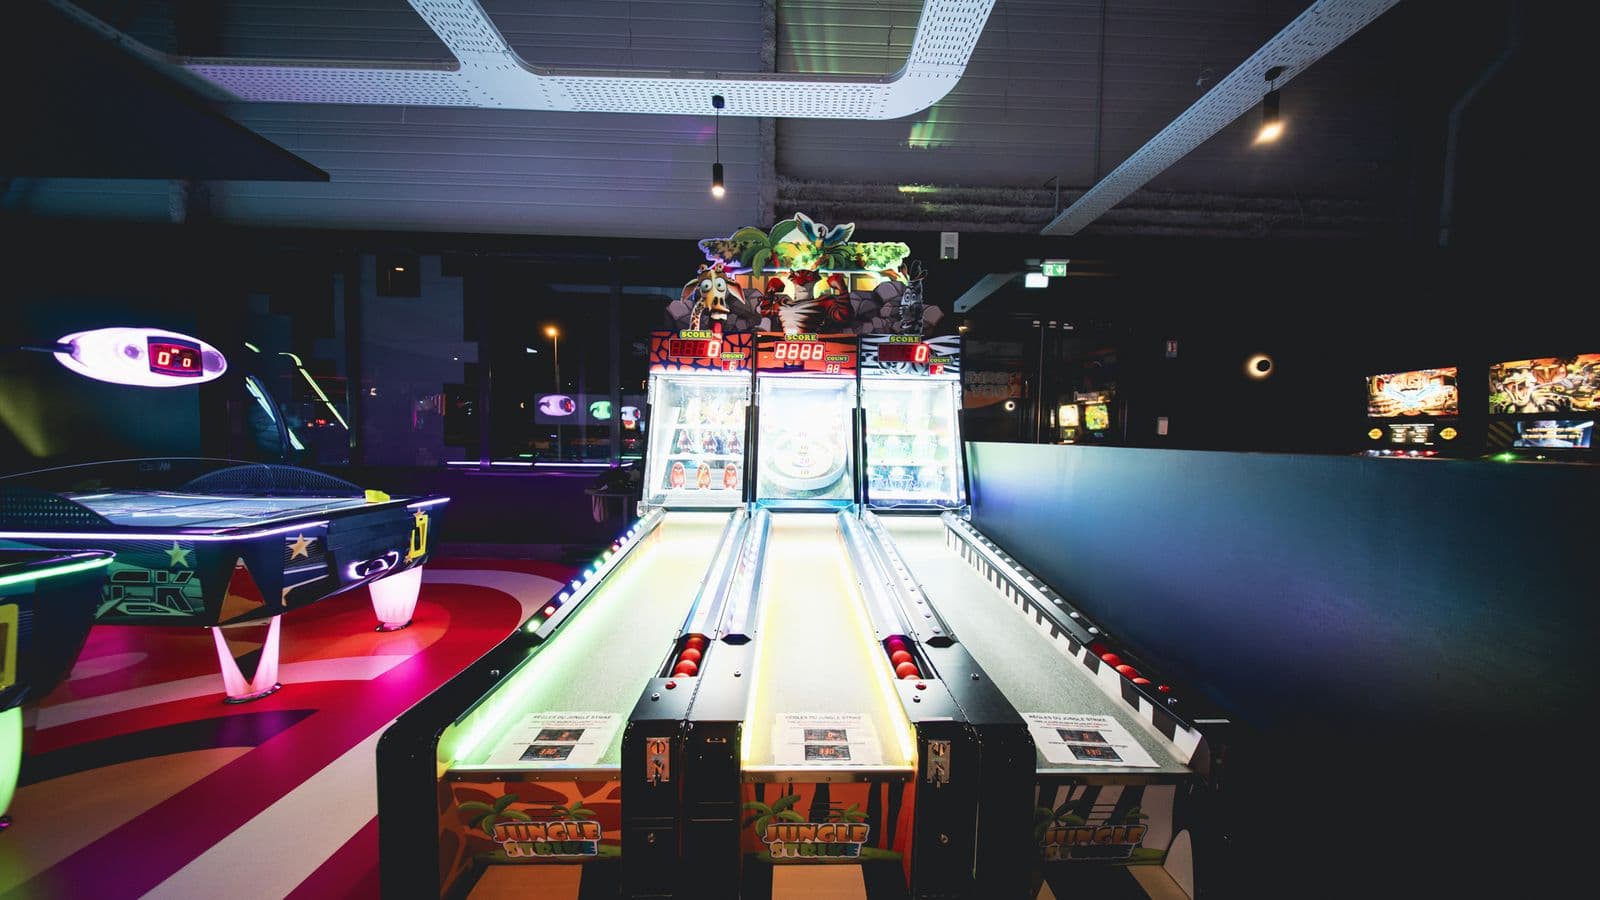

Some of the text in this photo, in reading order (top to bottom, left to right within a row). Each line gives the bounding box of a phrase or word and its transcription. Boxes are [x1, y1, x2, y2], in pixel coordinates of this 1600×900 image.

[681, 331, 712, 339] SCORE
[157, 351, 170, 366] 0
[775, 343, 824, 360] 8888
[915, 345, 928, 362] 0
[182, 357, 192, 368] 0
[826, 363, 840, 373] 88
[493, 822, 600, 842] JUNGLE
[763, 823, 868, 843] JUNGLE
[1041, 825, 1147, 847] JUNGLE
[504, 841, 597, 857] STRIKE
[771, 842, 861, 858] STRIKE
